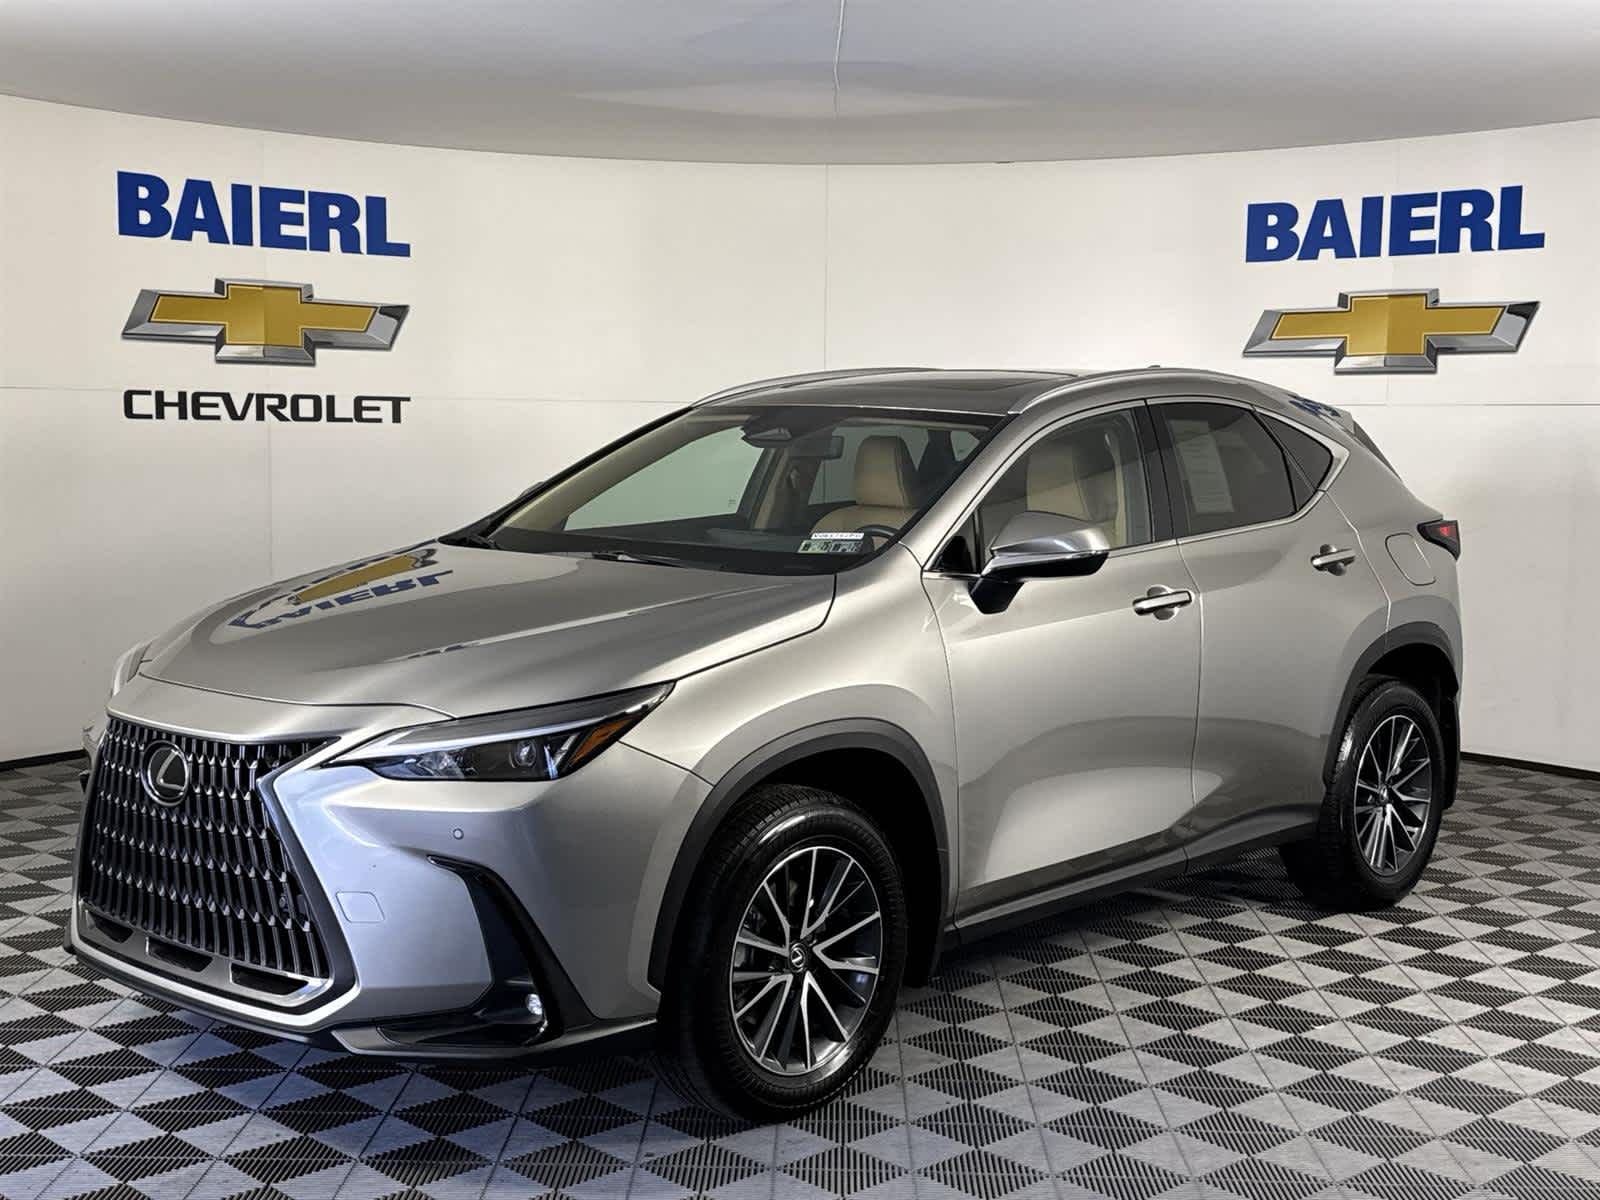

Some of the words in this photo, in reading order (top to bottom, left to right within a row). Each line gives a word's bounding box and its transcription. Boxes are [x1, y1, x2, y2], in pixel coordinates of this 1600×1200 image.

[117, 171, 409, 256] BAIERL
[1246, 185, 1544, 262] BAIERL
[124, 390, 410, 423] CHEVROLET
